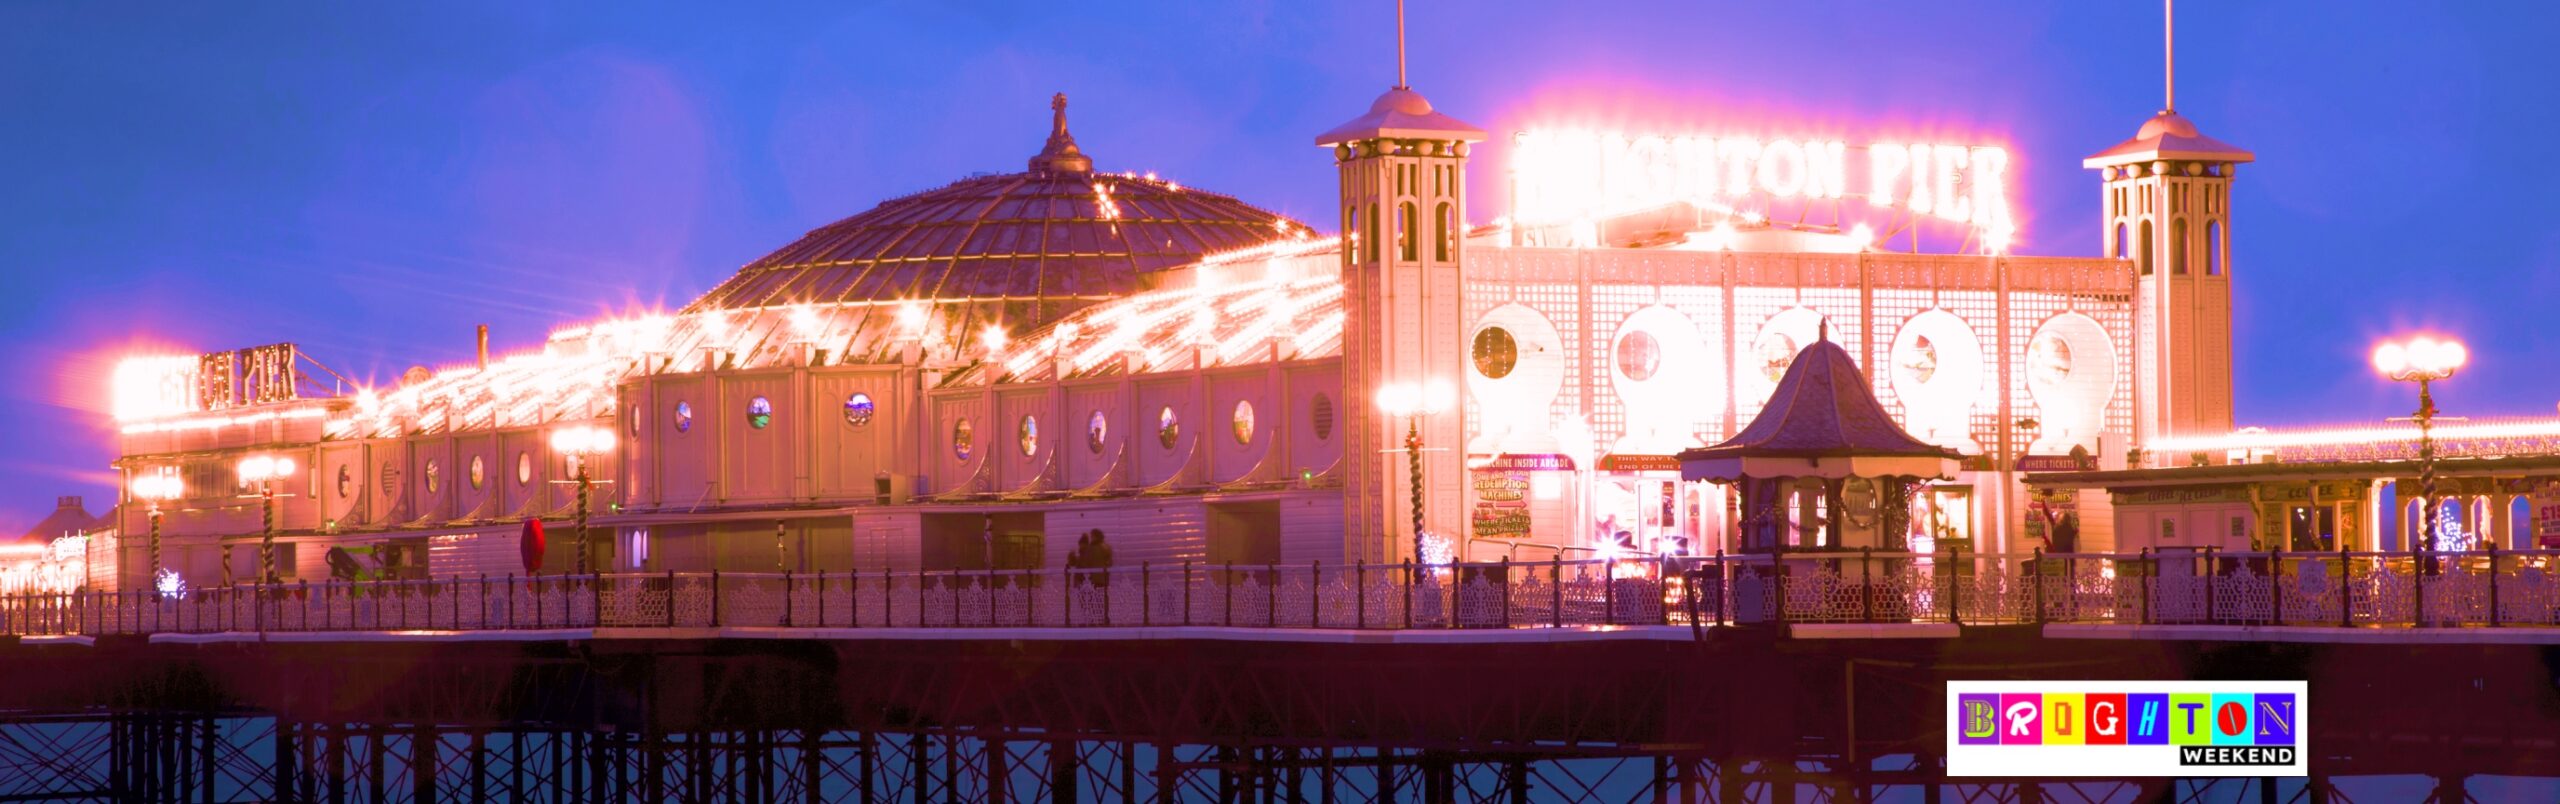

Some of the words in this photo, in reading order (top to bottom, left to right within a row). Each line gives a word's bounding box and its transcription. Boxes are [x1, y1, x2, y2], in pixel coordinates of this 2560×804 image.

[1513, 131, 1846, 217] IGHTON
[1868, 143, 2014, 230] PIER
[1485, 458, 1513, 468] ACHINE
[1514, 458, 1538, 468] INSIDE
[1540, 458, 1569, 468] ARCADE
[2025, 459, 2047, 469] WHERE
[2049, 459, 2075, 469] TICKETS
[1473, 479, 1529, 490] REDEMPTION
[1480, 490, 1524, 501] MACHINES
[2288, 483, 2334, 498] COEE
[2032, 493, 2073, 502] MAINES
